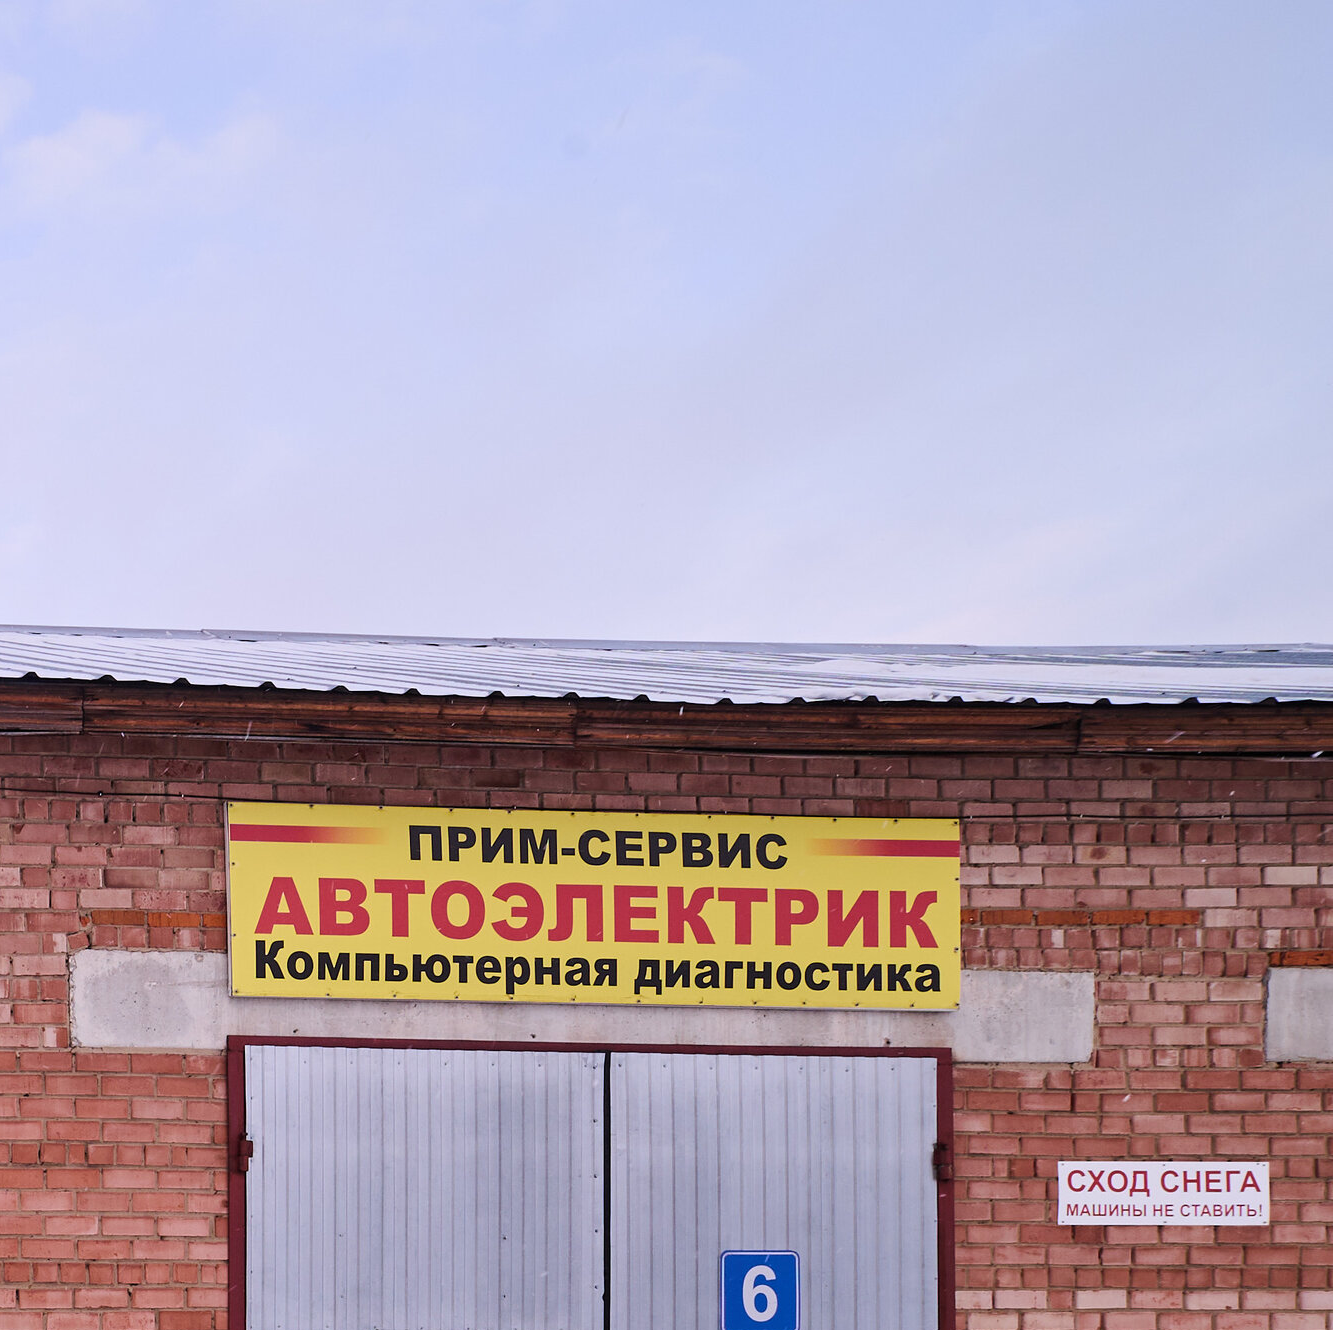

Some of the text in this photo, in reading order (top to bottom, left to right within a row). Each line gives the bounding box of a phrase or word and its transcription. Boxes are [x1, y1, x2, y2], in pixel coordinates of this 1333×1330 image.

[408, 824, 788, 870] ПРИМ-СЕРВИС
[254, 876, 939, 949] АВТОЭЛЕКТРИК
[255, 939, 941, 996] Компьютерная диагностика
[1067, 1169, 1262, 1198] СХОД СНЕГА
[1066, 1203, 1263, 1218] МАШИНЫ НЕ СТАВИТЬ!
[742, 1264, 778, 1323] 6
